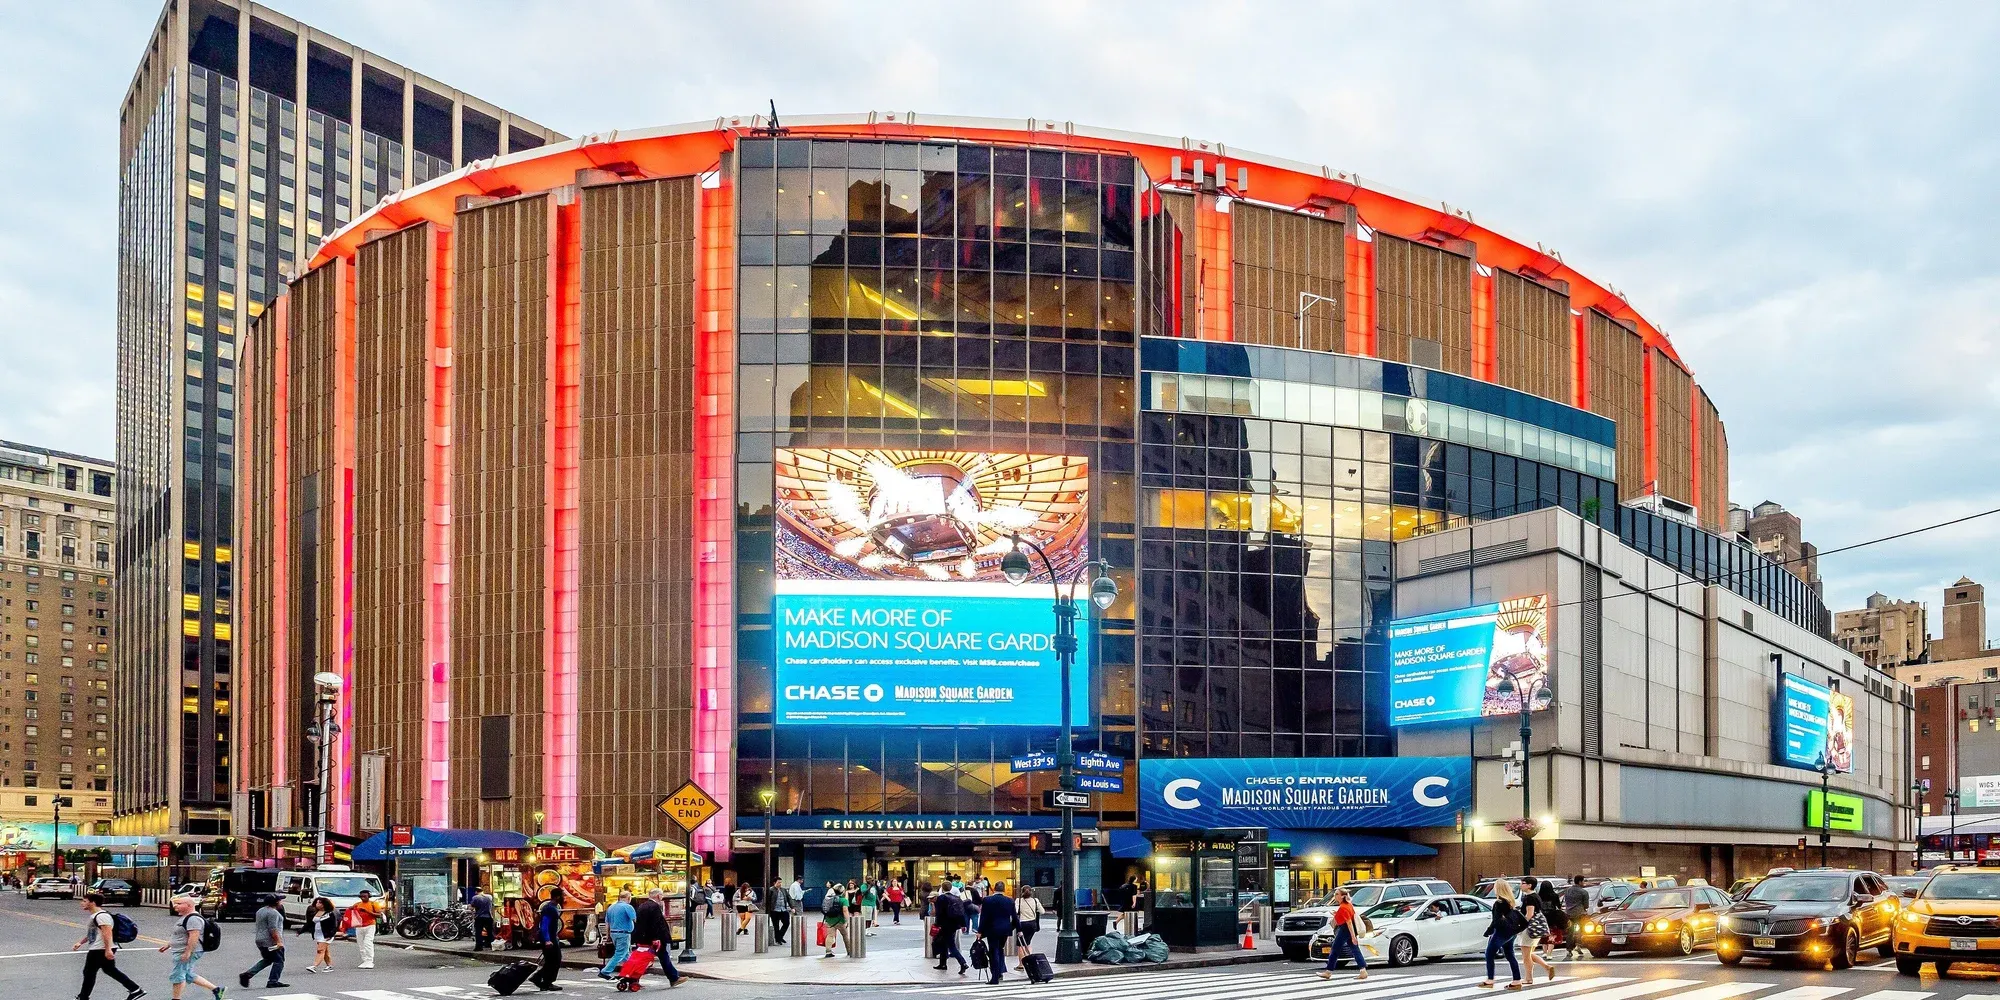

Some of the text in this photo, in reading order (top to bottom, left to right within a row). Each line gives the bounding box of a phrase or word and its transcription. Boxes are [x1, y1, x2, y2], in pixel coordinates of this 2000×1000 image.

[784, 608, 952, 627] MAKE MORE OF
[784, 630, 1056, 652] MADISON SQUARE GARDE
[1395, 650, 1413, 658] MAKE
[1414, 647, 1434, 656] MORE
[1395, 647, 1486, 666] MADISON SQUARE GARDEN
[785, 685, 860, 700] CHASE
[895, 685, 937, 699] MADISON
[940, 685, 974, 700] SQUARE
[1394, 698, 1426, 709] CHASE
[1014, 757, 1054, 768] West 33rd St
[1080, 756, 1119, 768] Eighth Ave
[1081, 778, 1091, 787] Joe
[1093, 779, 1109, 788] Louis
[1300, 776, 1367, 784] ENTRANCE
[1163, 778, 1201, 810] C
[1222, 788, 1280, 805] MADISON
[1285, 787, 1334, 805] SQUARE
[1412, 776, 1450, 807] C
[674, 798, 705, 806] DEAD
[678, 810, 700, 818] END
[823, 820, 1014, 830] PENNSYLVANIA STATION
[496, 850, 517, 860] HOT DOG
[535, 849, 579, 860] ALAFEL
